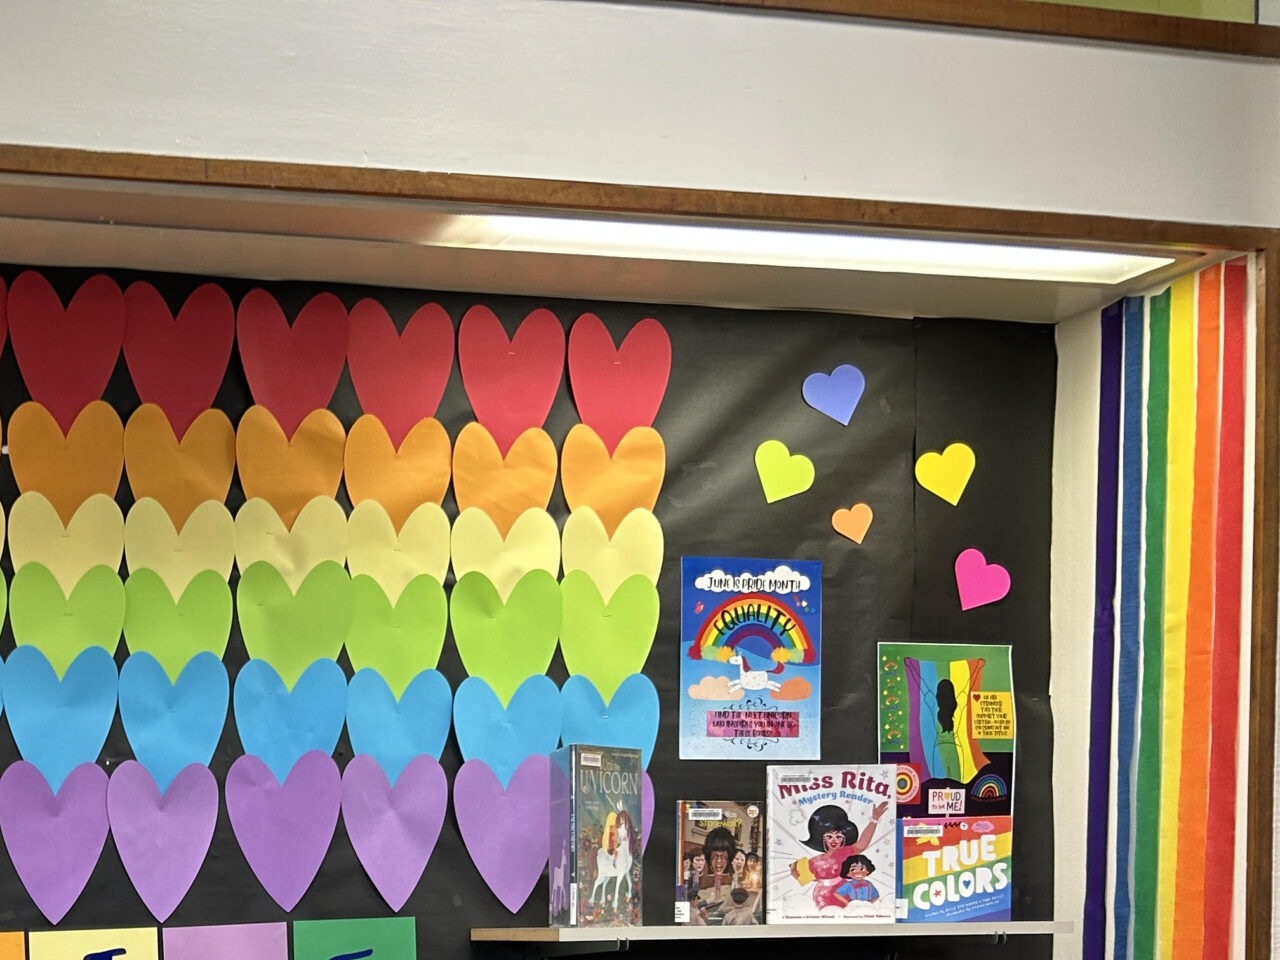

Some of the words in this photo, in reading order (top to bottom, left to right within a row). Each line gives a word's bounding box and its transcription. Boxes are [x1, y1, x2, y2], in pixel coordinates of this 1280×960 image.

[707, 577, 731, 589] JUNE
[733, 577, 739, 589] IS
[742, 577, 766, 590] PRIDE
[768, 579, 801, 590] MONTH
[713, 603, 796, 636] EQUALITY
[580, 769, 638, 795] UNICORN
[841, 770, 892, 799] Rita,
[798, 791, 837, 806] Mystery
[839, 790, 873, 805] Reader
[946, 800, 963, 812] ME!
[922, 834, 997, 878] TRUE
[913, 862, 1008, 910] COLORS
